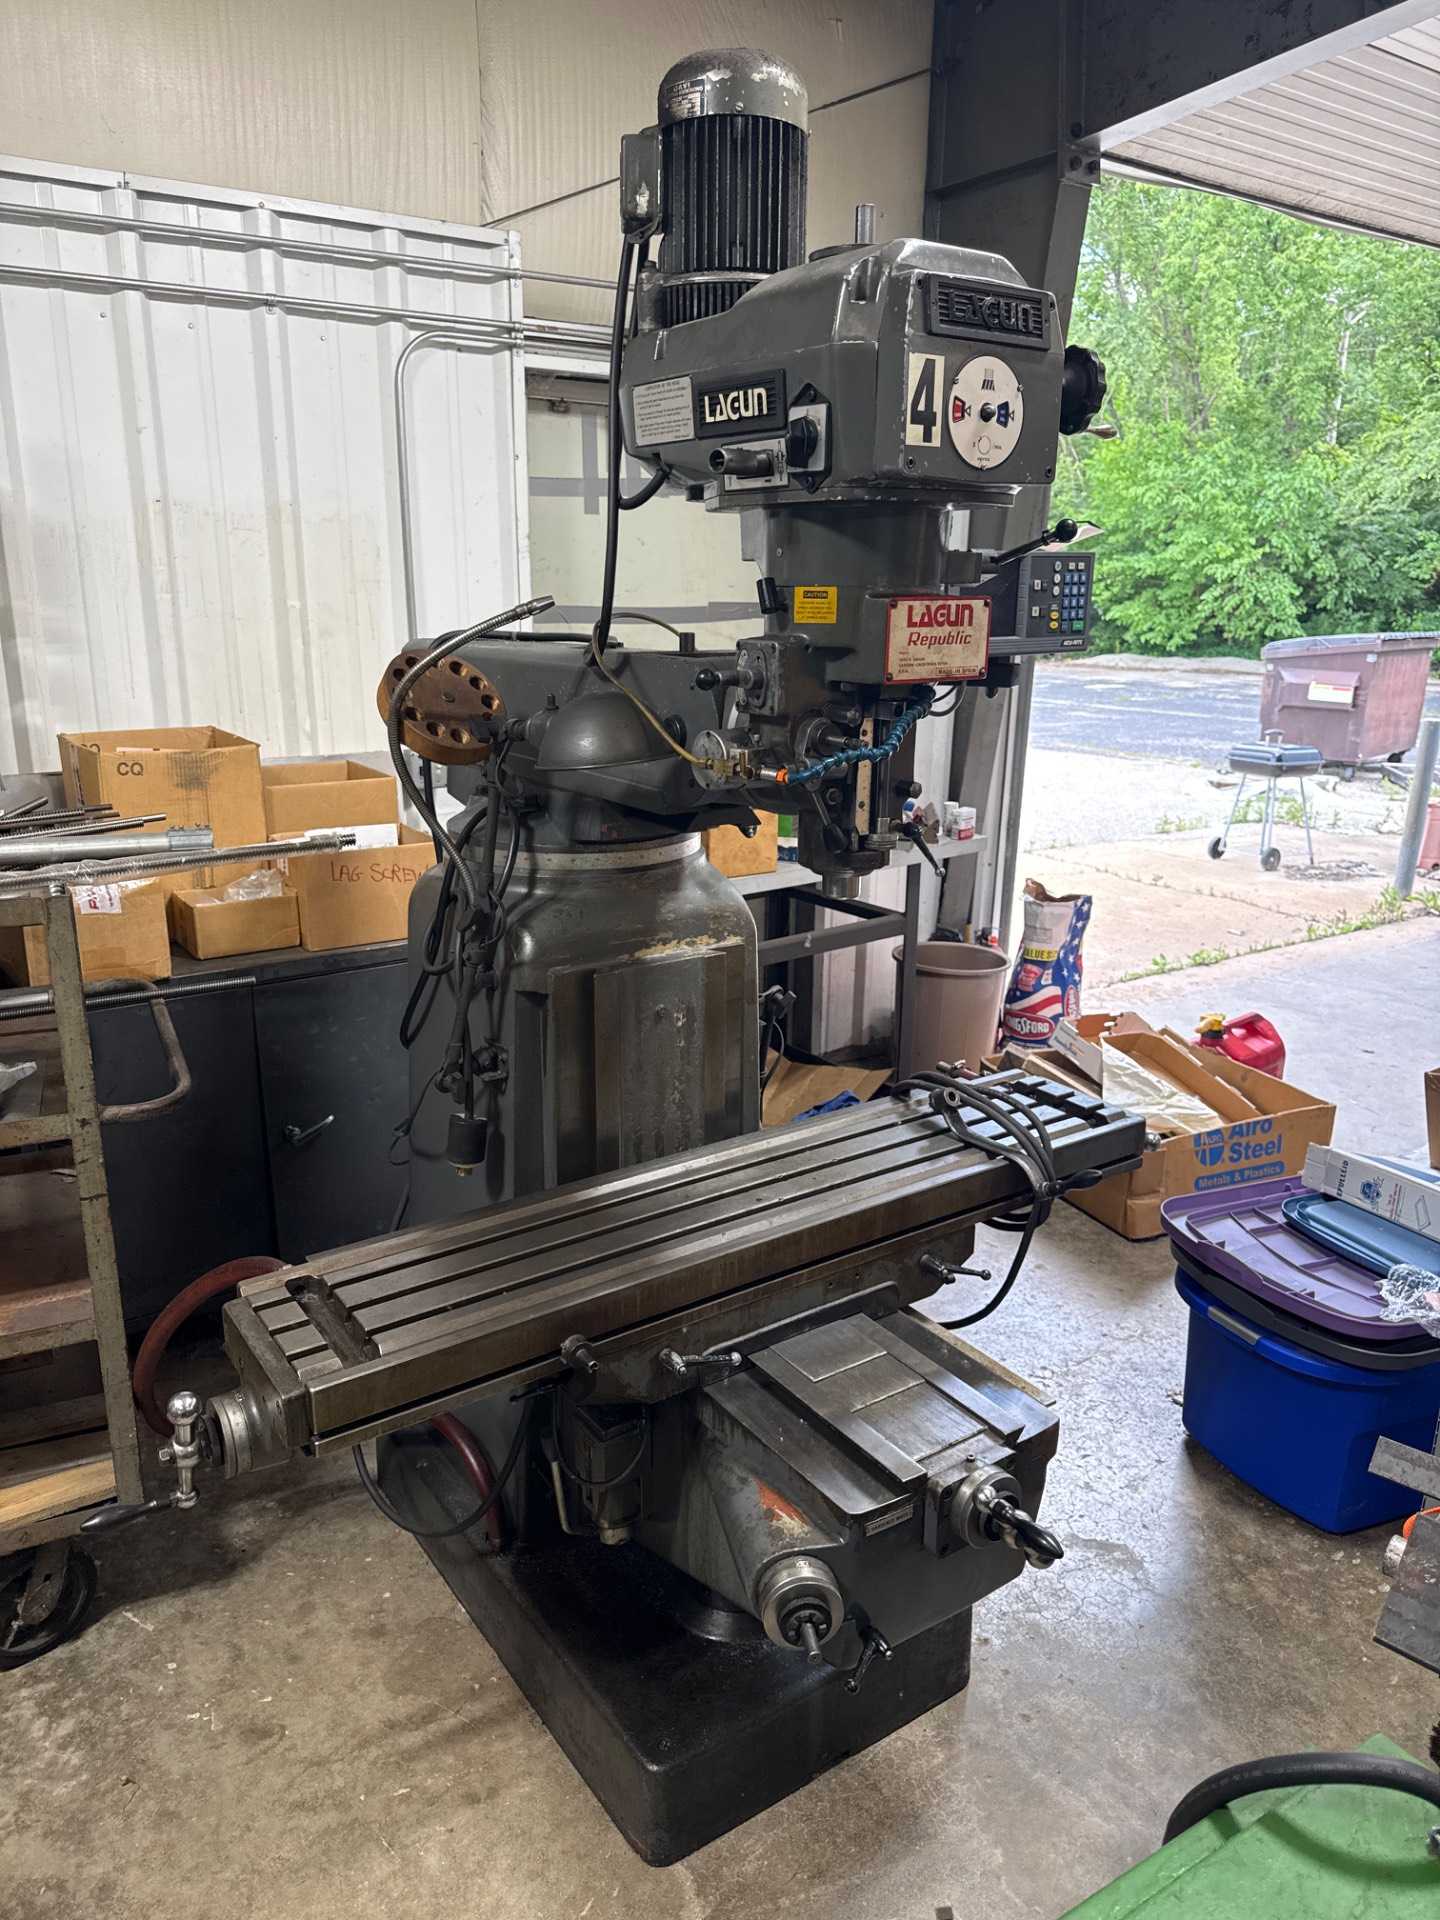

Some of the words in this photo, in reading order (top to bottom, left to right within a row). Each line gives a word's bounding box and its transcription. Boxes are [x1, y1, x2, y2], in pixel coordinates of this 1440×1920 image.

[704, 387, 768, 423] LAGUN
[911, 358, 937, 443] 4
[906, 603, 974, 628] LAGUN
[907, 630, 973, 649] Republic
[116, 762, 144, 776] CQ
[1008, 1016, 1050, 1034] GSFORD
[1228, 1134, 1282, 1163] Steel
[1200, 1174, 1231, 1187] Metals
[1234, 1170, 1241, 1181] &
[1244, 1166, 1281, 1179] Plastics
